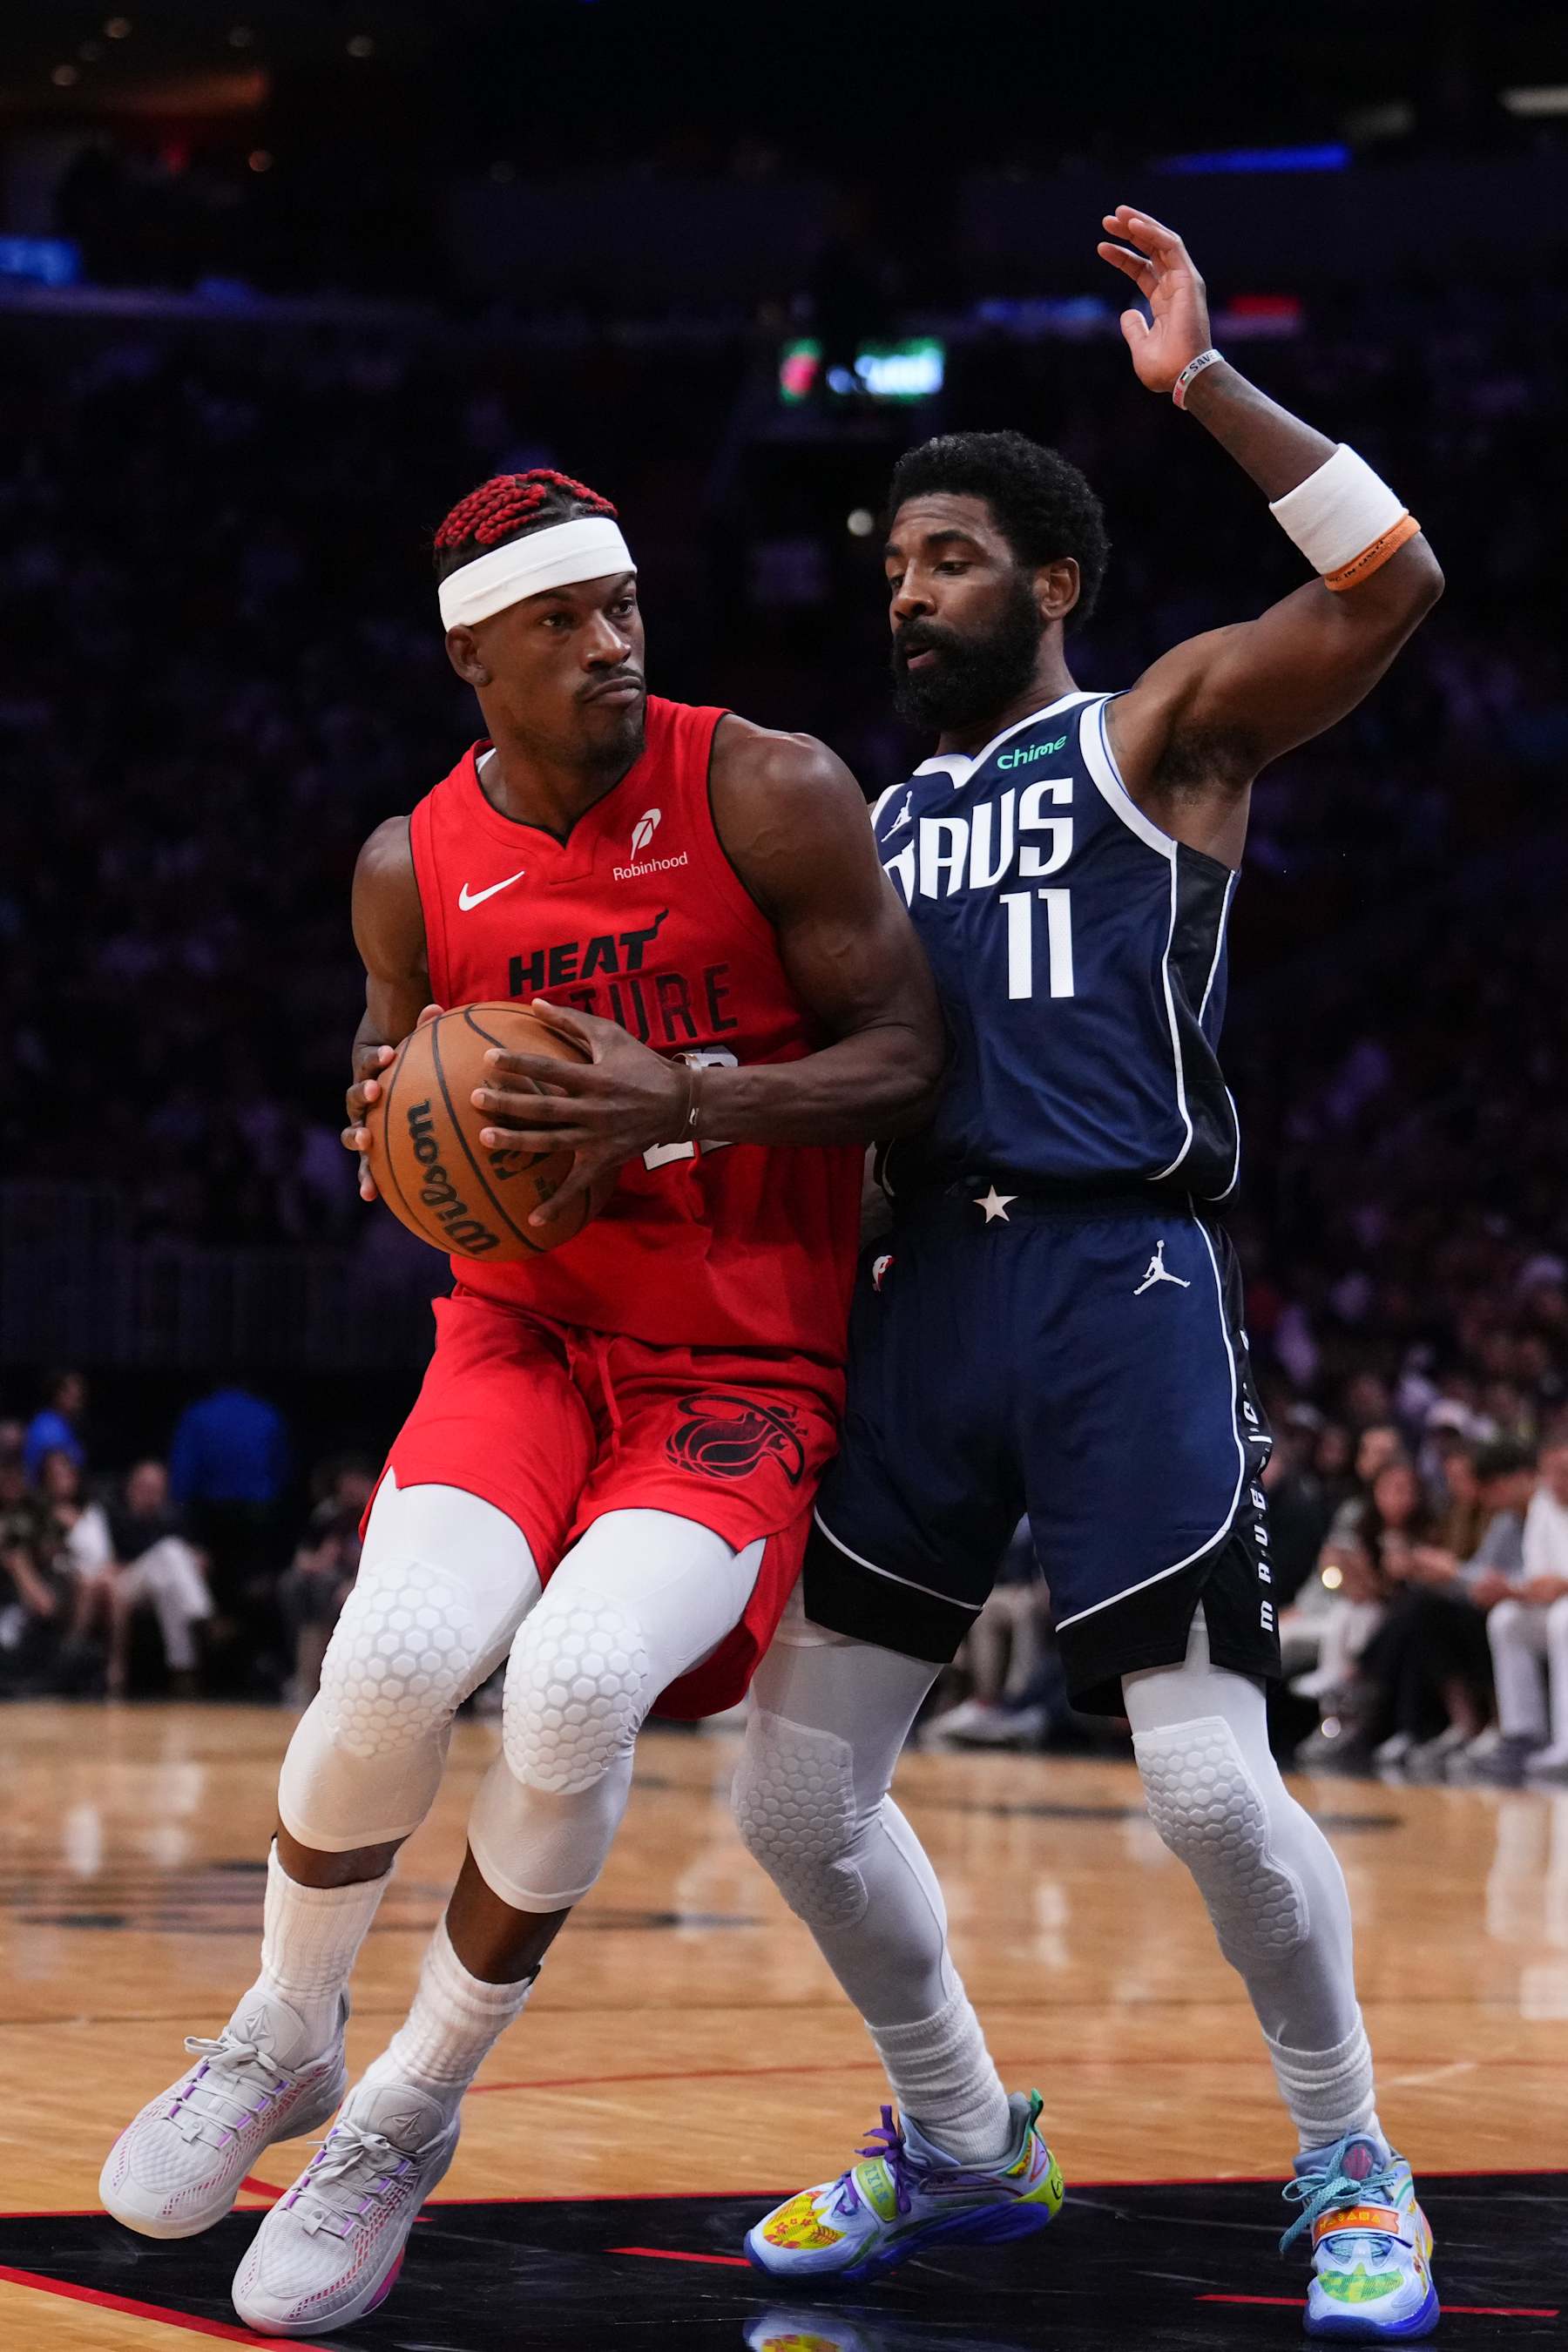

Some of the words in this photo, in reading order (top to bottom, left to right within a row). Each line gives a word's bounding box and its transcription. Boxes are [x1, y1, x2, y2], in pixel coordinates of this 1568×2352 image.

[612, 851, 688, 882] Robinhood
[509, 908, 669, 997] HEAT
[999, 889, 1074, 999] 11
[570, 961, 738, 1045] TURE
[407, 1098, 500, 1254] Wilson
